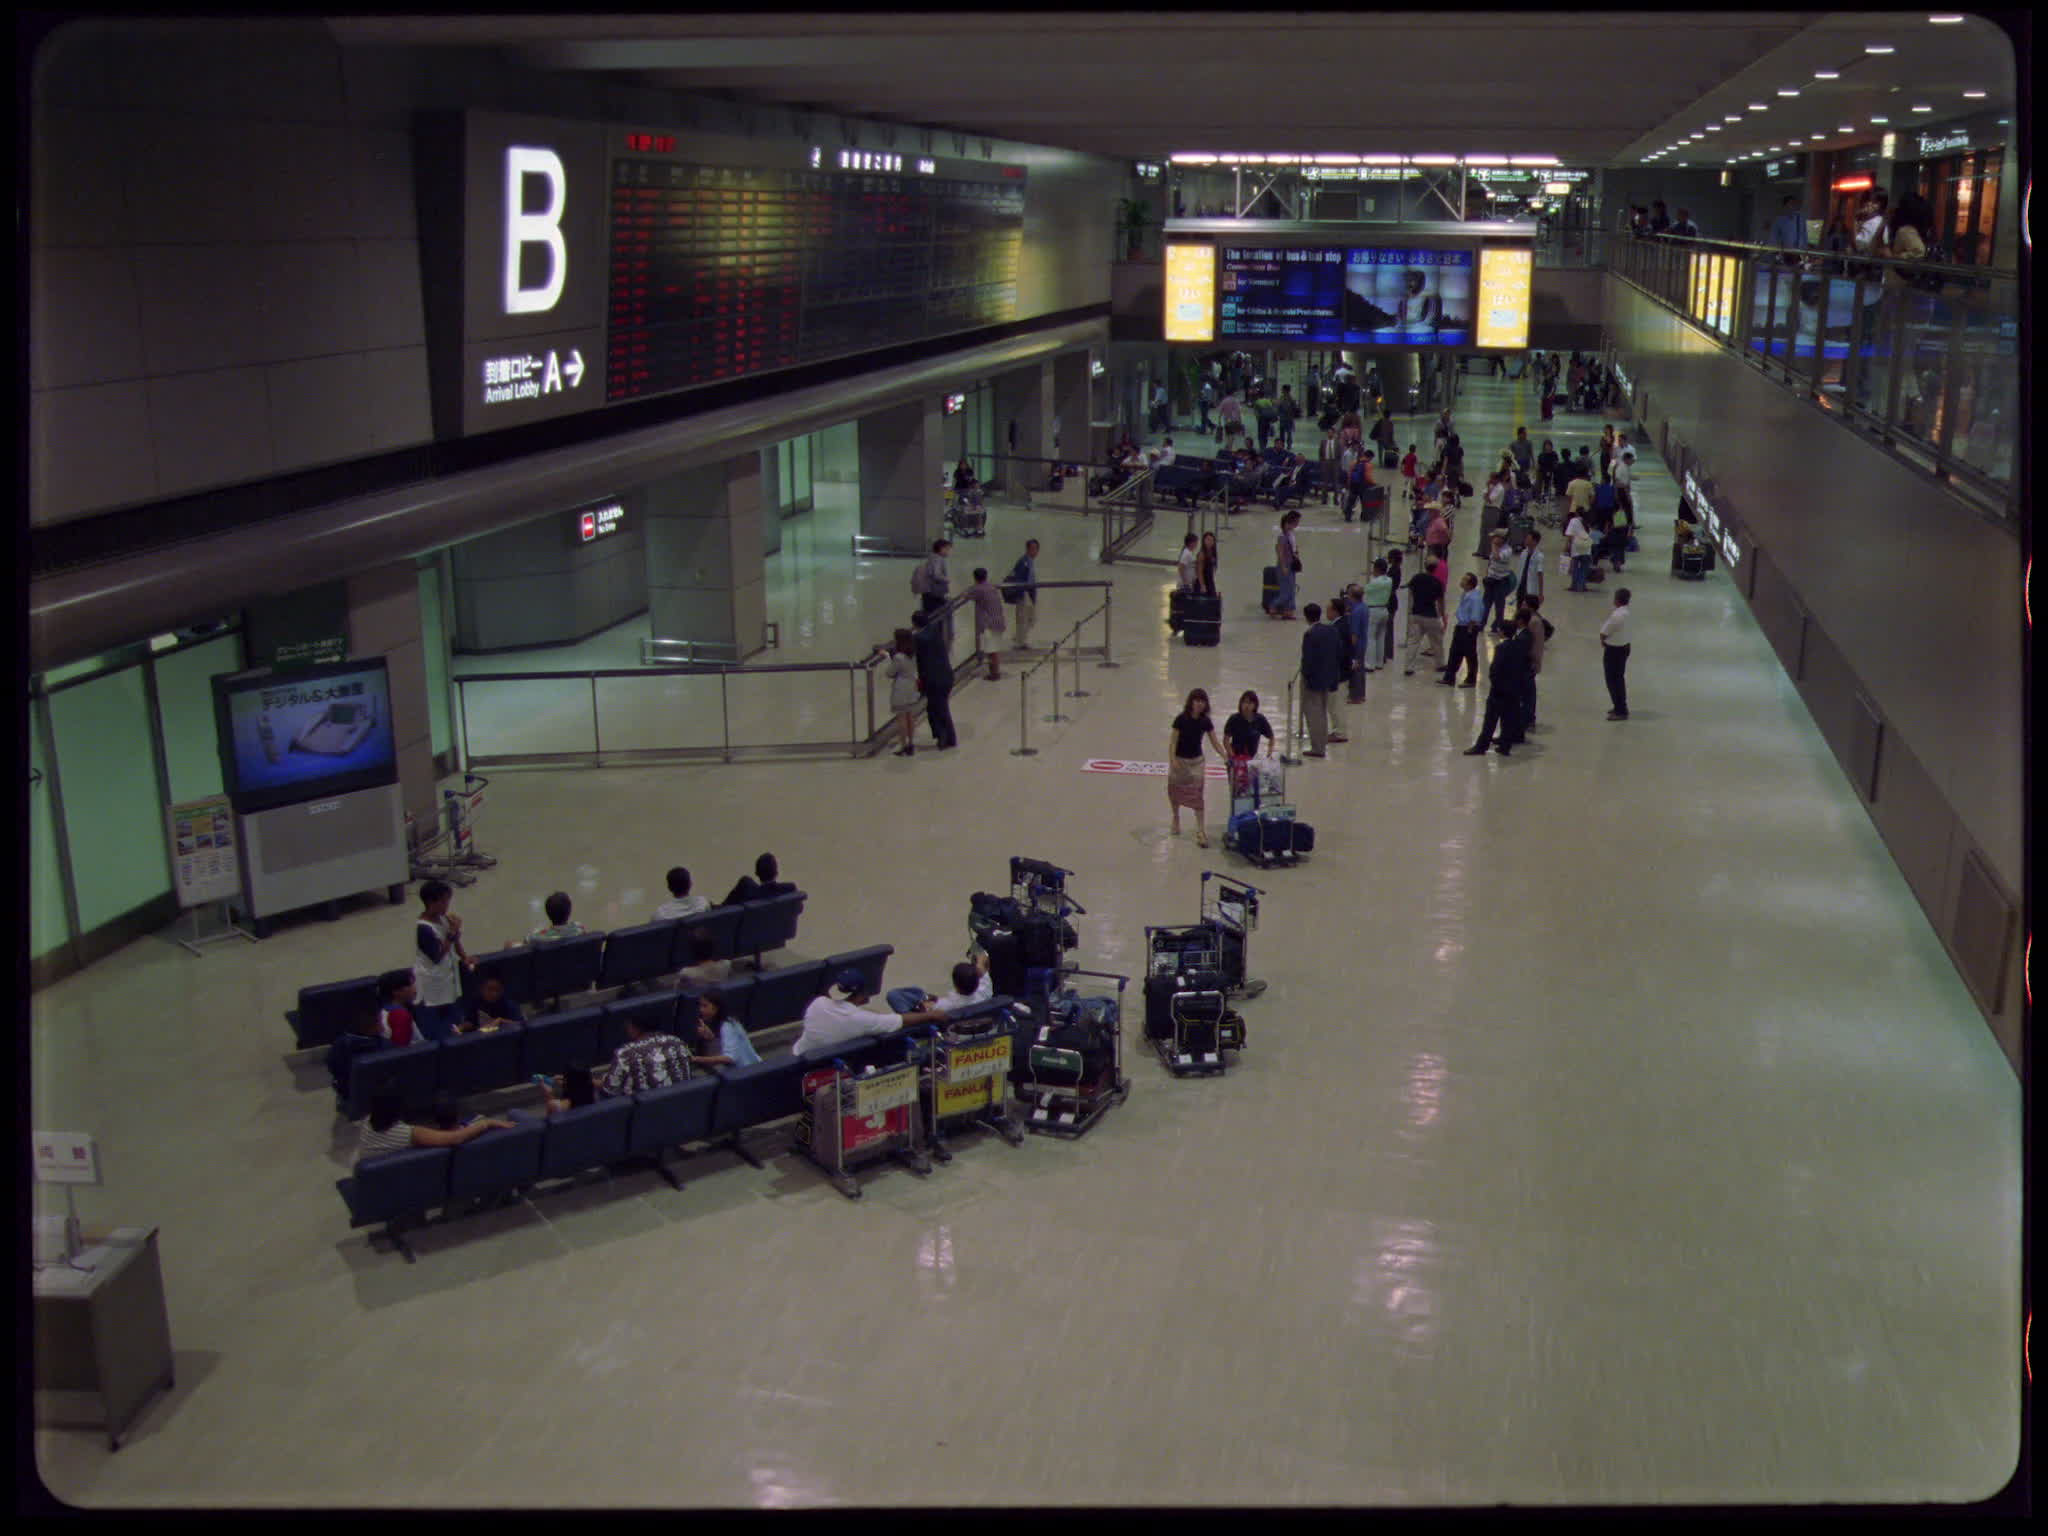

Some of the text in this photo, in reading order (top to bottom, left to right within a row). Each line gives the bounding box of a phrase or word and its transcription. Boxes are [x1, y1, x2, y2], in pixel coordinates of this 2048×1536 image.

[505, 145, 567, 315] B
[1226, 250, 1241, 261] The
[1325, 251, 1342, 265] stop
[544, 350, 562, 394] A
[486, 379, 540, 404] Arrival Lobby
